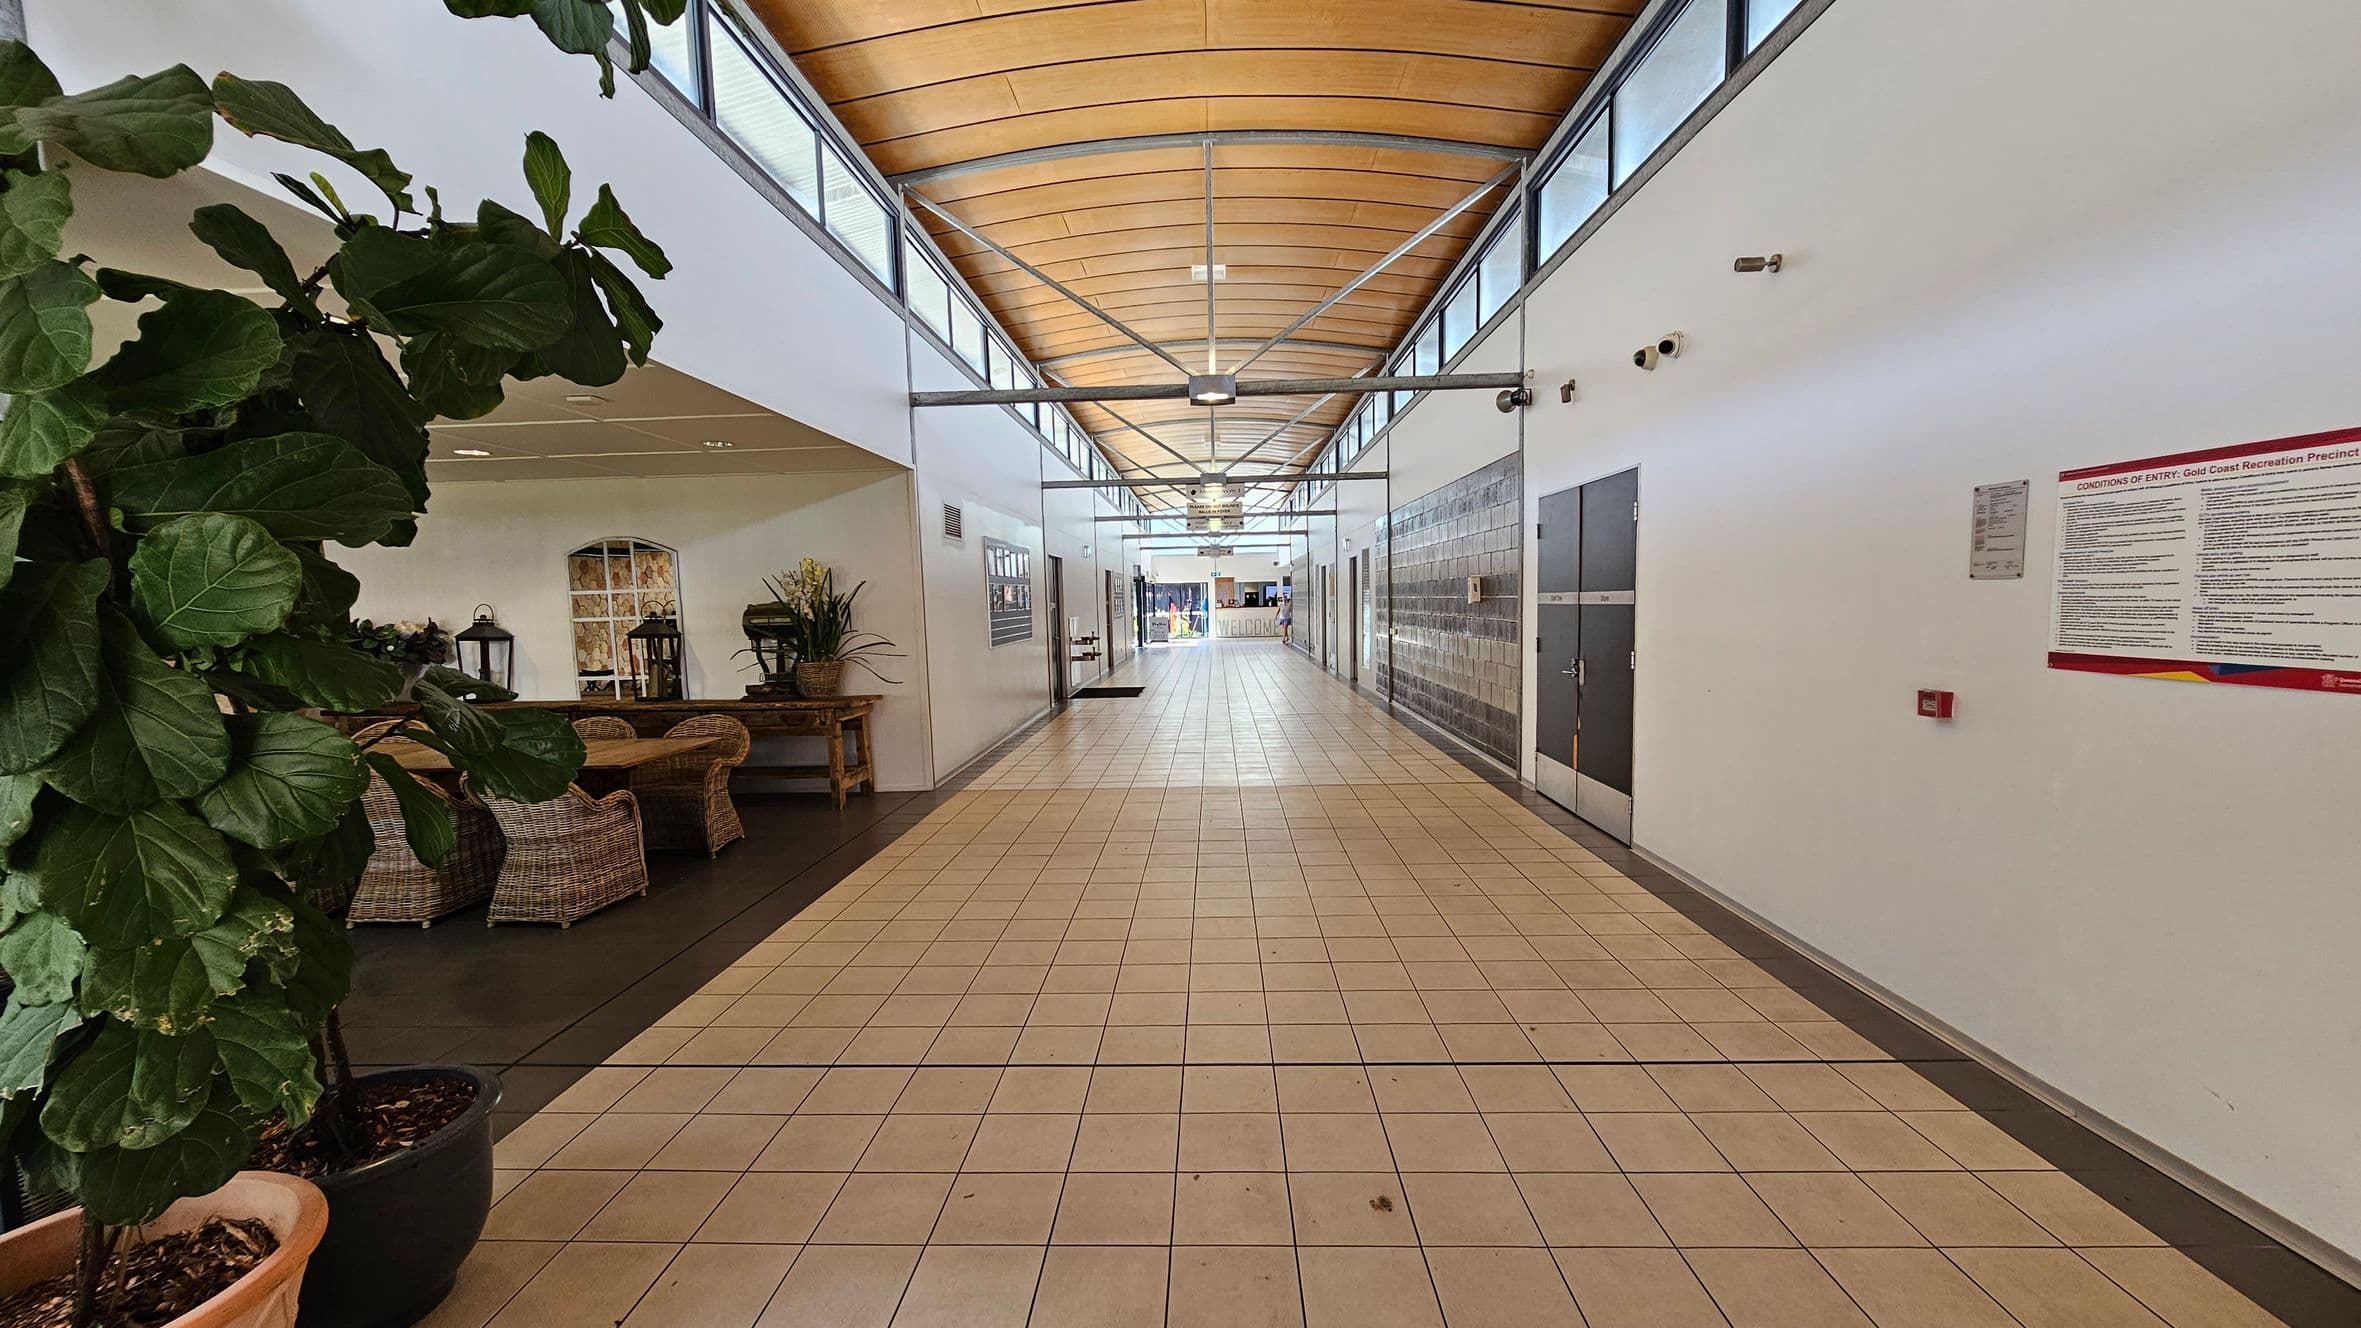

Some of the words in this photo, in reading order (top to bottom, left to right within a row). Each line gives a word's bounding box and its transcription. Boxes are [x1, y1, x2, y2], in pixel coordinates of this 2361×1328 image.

[2077, 478, 2129, 491] CONDITIONS
[2130, 475, 2143, 484] OF
[2145, 470, 2181, 482] ENTRY:
[2183, 467, 2207, 477] Gold
[2209, 463, 2240, 474] Coast
[2242, 455, 2304, 470] Recreation
[2307, 448, 2360, 462] Precinct
[1217, 618, 1280, 636] WELCOME
